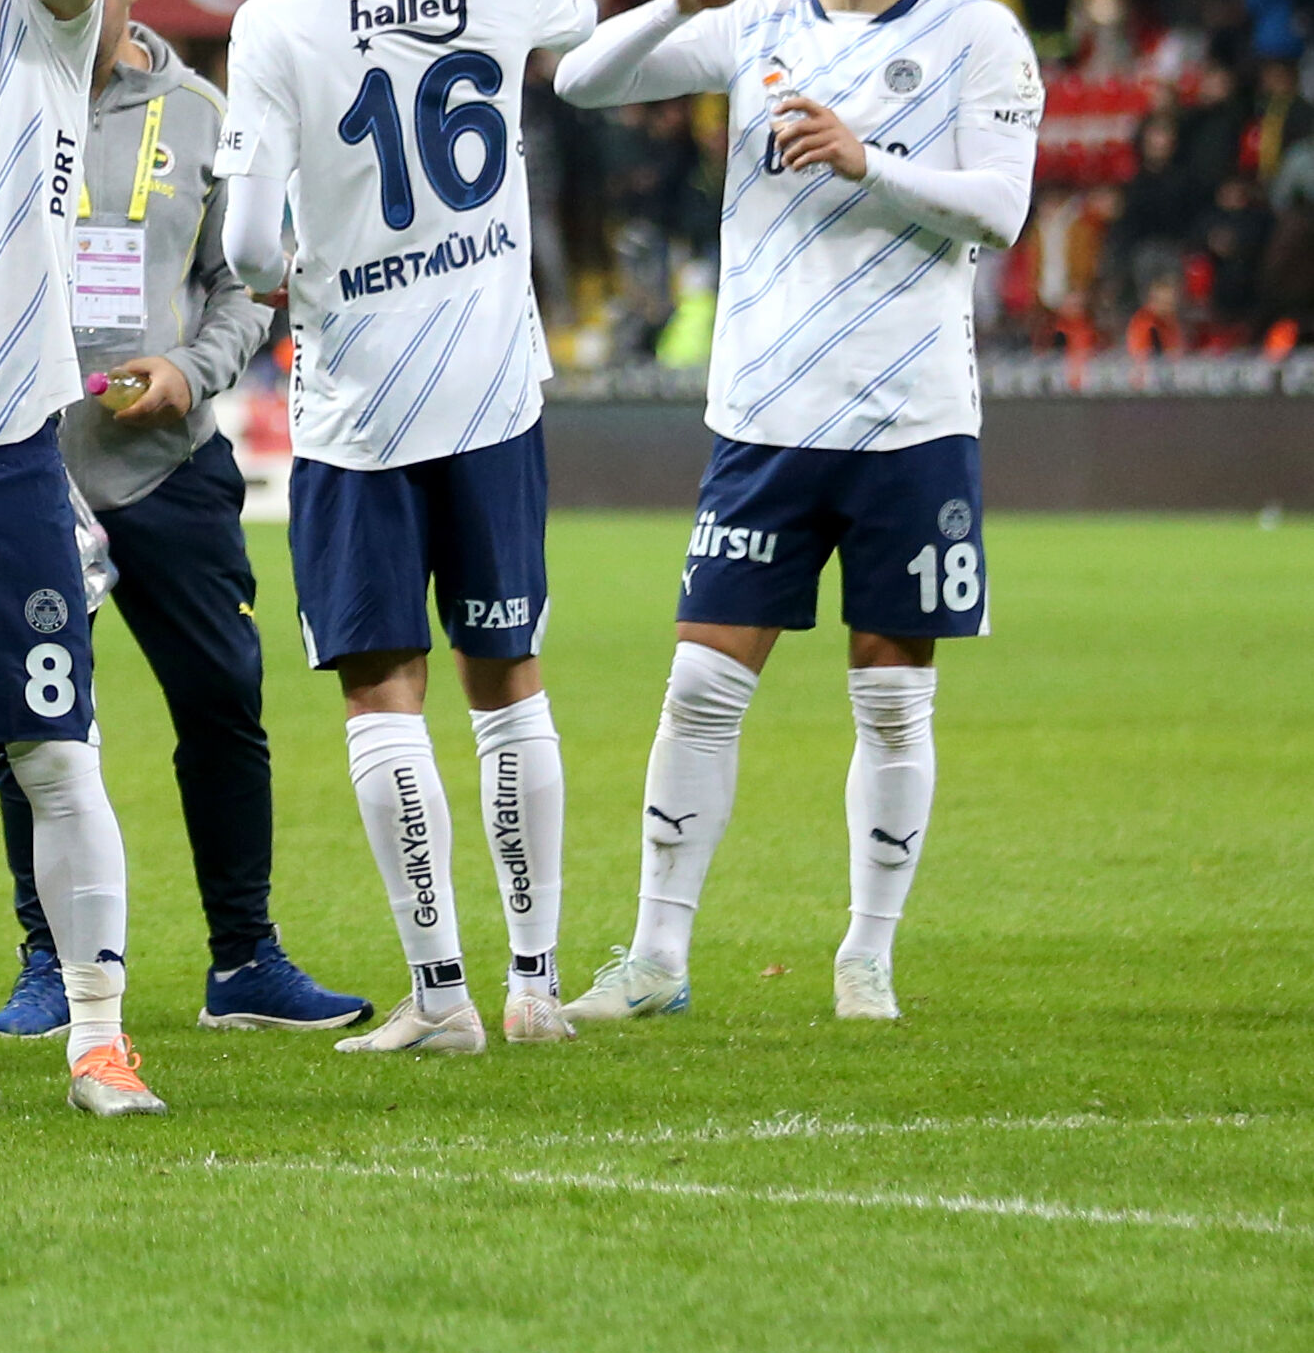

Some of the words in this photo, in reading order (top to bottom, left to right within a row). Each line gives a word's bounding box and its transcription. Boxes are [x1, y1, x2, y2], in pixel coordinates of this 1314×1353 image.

[50, 129, 76, 218] PORT
[338, 49, 507, 231] 16
[685, 510, 778, 564] ürsu
[906, 541, 981, 614] 18
[24, 642, 76, 718] 8
